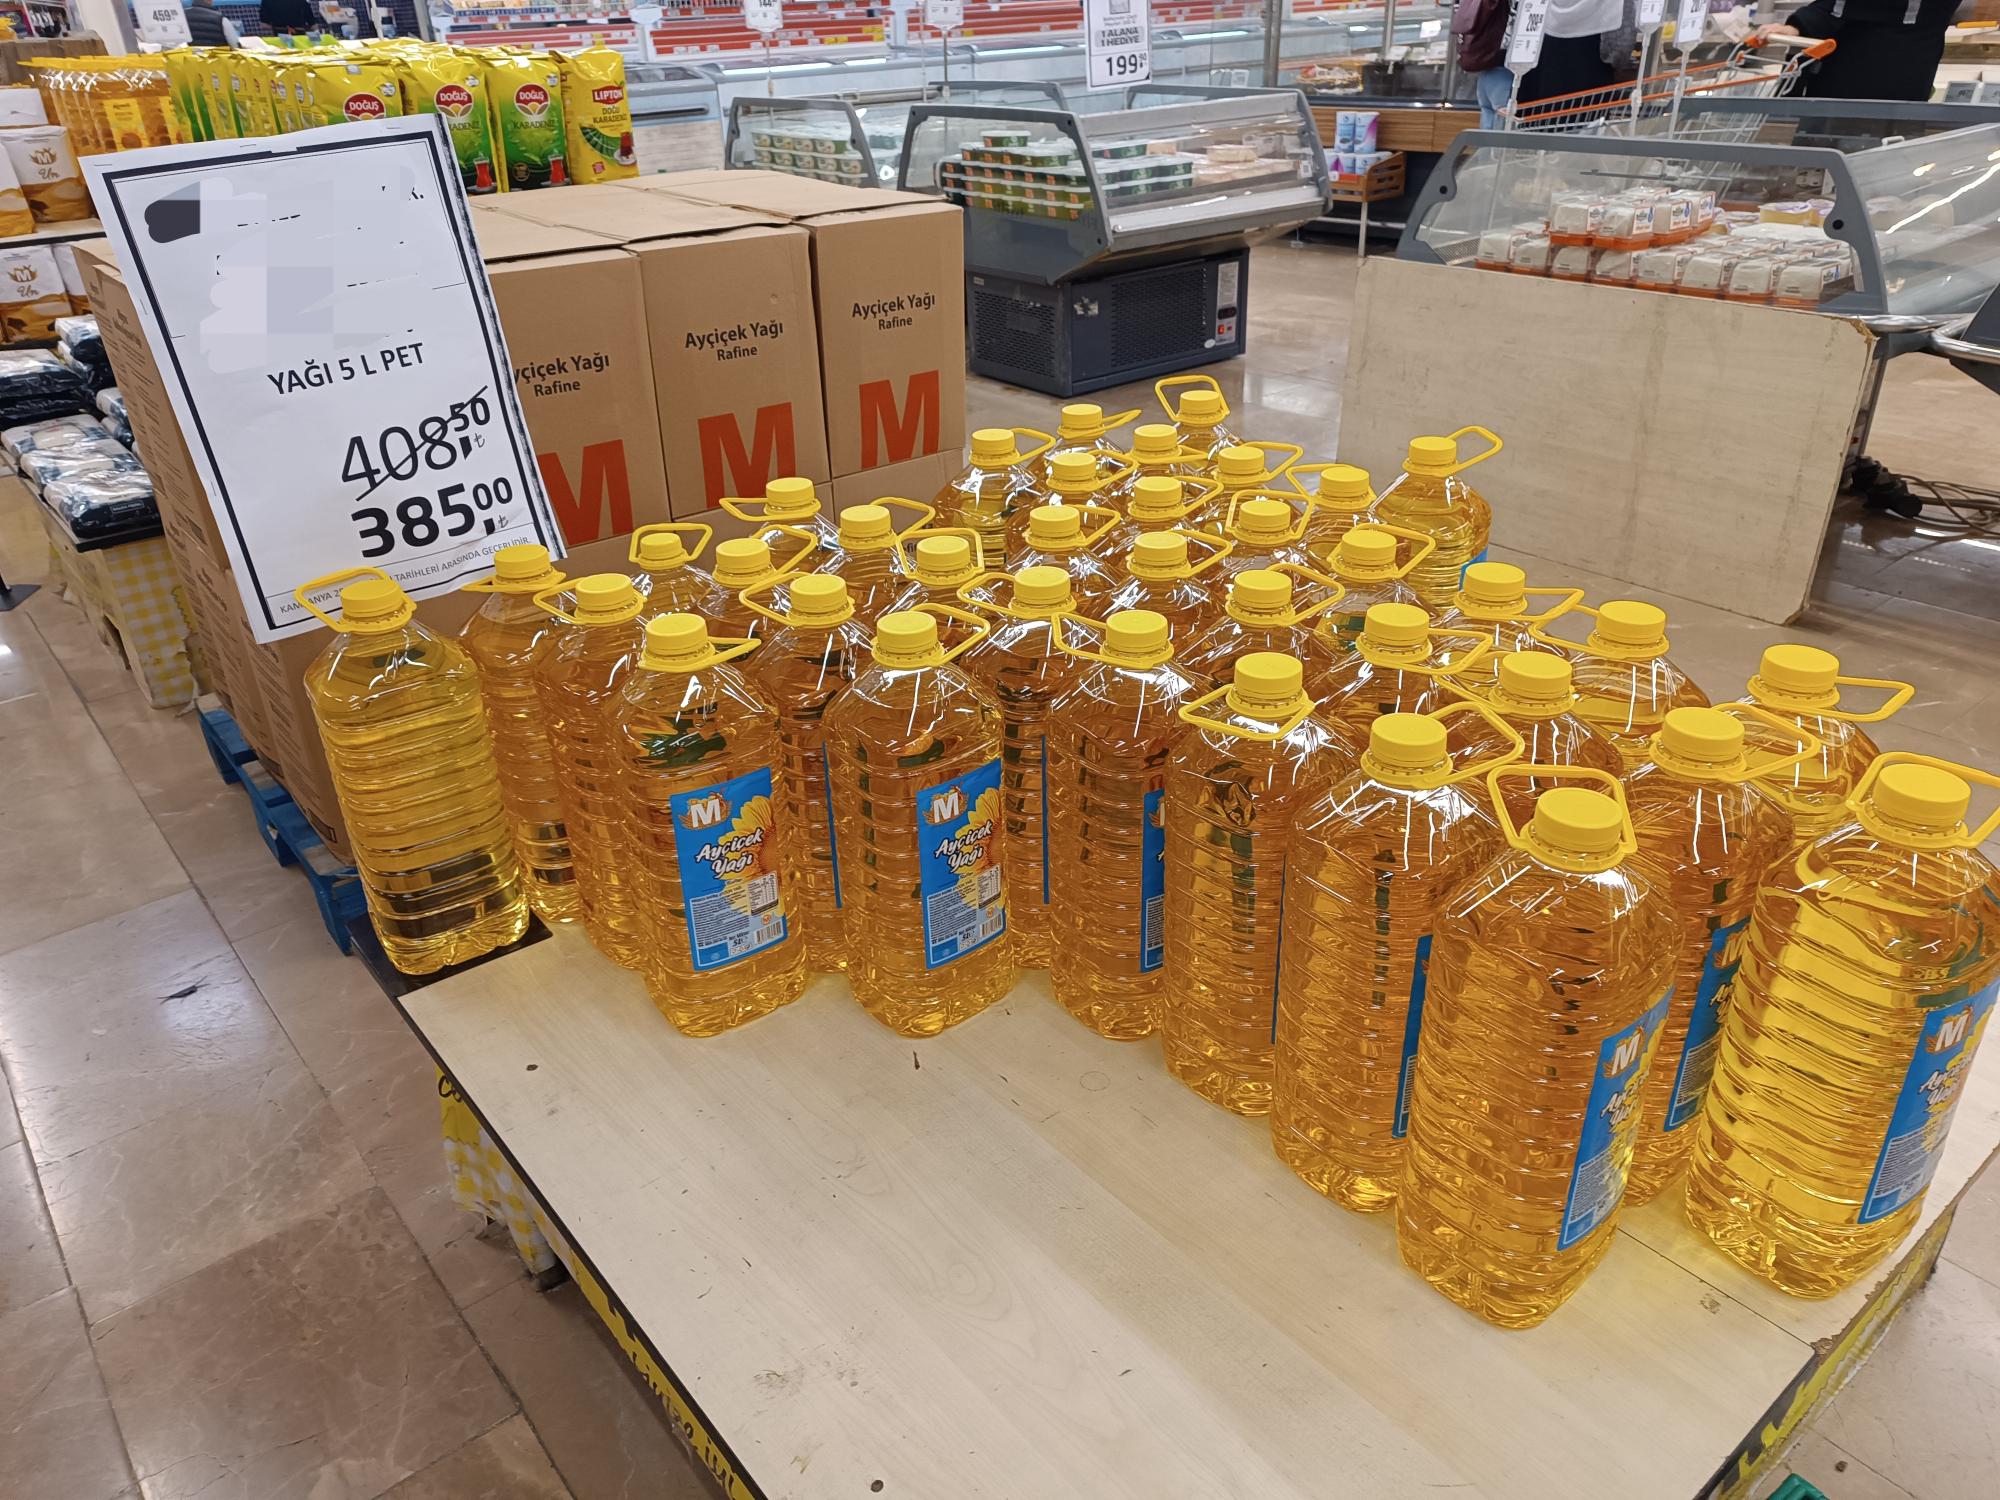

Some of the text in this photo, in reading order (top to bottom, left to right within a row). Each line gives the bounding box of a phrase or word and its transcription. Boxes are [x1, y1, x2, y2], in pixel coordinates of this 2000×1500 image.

[1107, 27, 1138, 37] ALANA
[349, 100, 379, 111] DOĞUŞ
[440, 90, 468, 101] DOĞUŞ
[519, 91, 545, 101] DOĞUŞ
[594, 90, 623, 101] LIPTON
[852, 292, 935, 320] Ayçiçek Yağı
[685, 320, 783, 350] Ayçiçek Yağı
[878, 316, 912, 331] Rafine
[514, 352, 610, 384] yçiçek Yağı
[717, 346, 758, 361] Rafine
[267, 342, 423, 395] YAĞI 5 L PET
[534, 380, 581, 397] Rafine
[859, 370, 940, 470] M
[697, 402, 796, 509] M
[536, 439, 634, 546] M
[441, 550, 481, 571] ARASINDA
[690, 798, 721, 828] M
[933, 792, 960, 823] M
[696, 828, 764, 863] Ayçiçek
[935, 820, 993, 858] Ayçiçek
[712, 852, 753, 879] Yağı
[948, 845, 983, 873] Yağı
[1934, 1013, 1971, 1052] M
[1611, 1032, 1640, 1075] M
